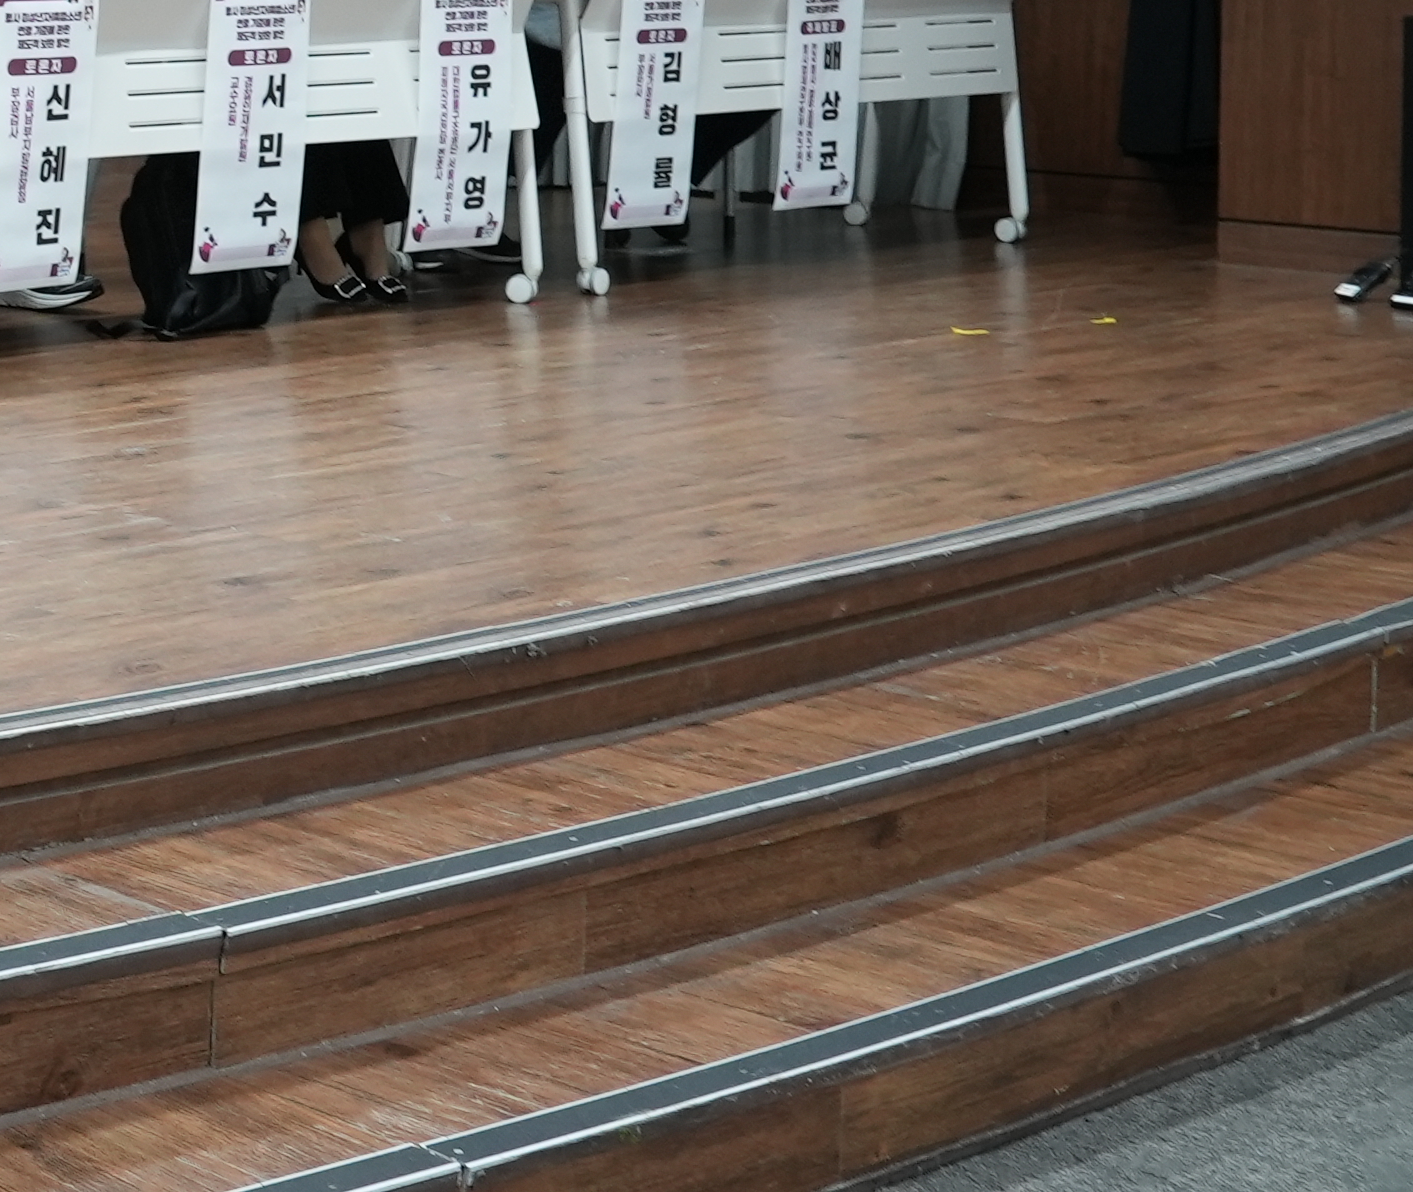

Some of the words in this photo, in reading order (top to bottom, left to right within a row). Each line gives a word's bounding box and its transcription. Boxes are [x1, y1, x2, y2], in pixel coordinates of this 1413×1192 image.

[25, 58, 63, 74] 토론자
[243, 50, 278, 64] 토론자
[819, 41, 842, 171] 배상균
[35, 84, 71, 246] 신혜진
[252, 73, 287, 227] 서민수
[463, 64, 492, 210] 유가영
